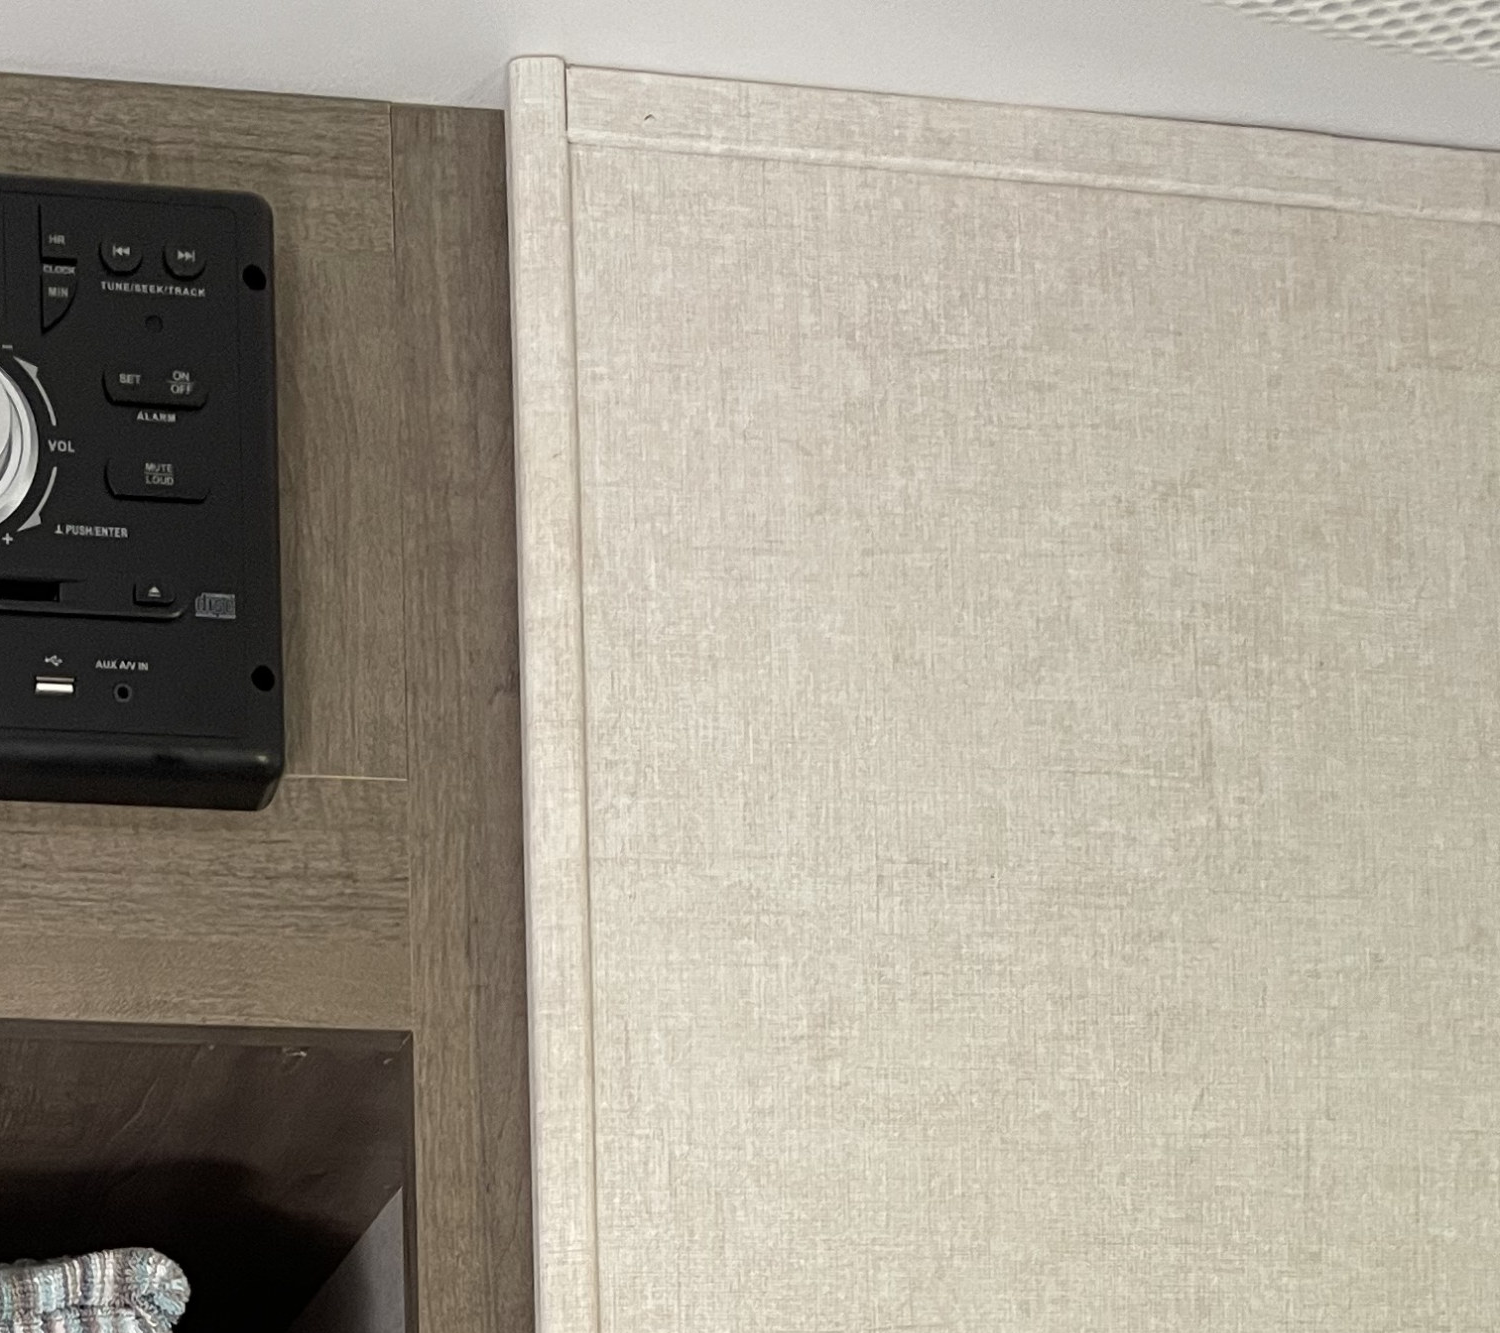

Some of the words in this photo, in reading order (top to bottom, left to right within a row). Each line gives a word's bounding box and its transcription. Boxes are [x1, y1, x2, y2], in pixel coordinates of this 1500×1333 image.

[49, 235, 66, 245] HR
[43, 265, 76, 275] CLOCK
[48, 286, 68, 297] MIN
[101, 281, 206, 297] TUNE/SEEK/TRACK
[119, 374, 141, 384] SET
[172, 370, 190, 382] ON
[170, 384, 193, 394] OFF
[137, 411, 177, 422] ALARM
[47, 439, 75, 453] VOL
[145, 463, 173, 473] MUTE
[145, 475, 174, 485] LOUD
[95, 659, 117, 670] AUX
[138, 661, 149, 671] IN
